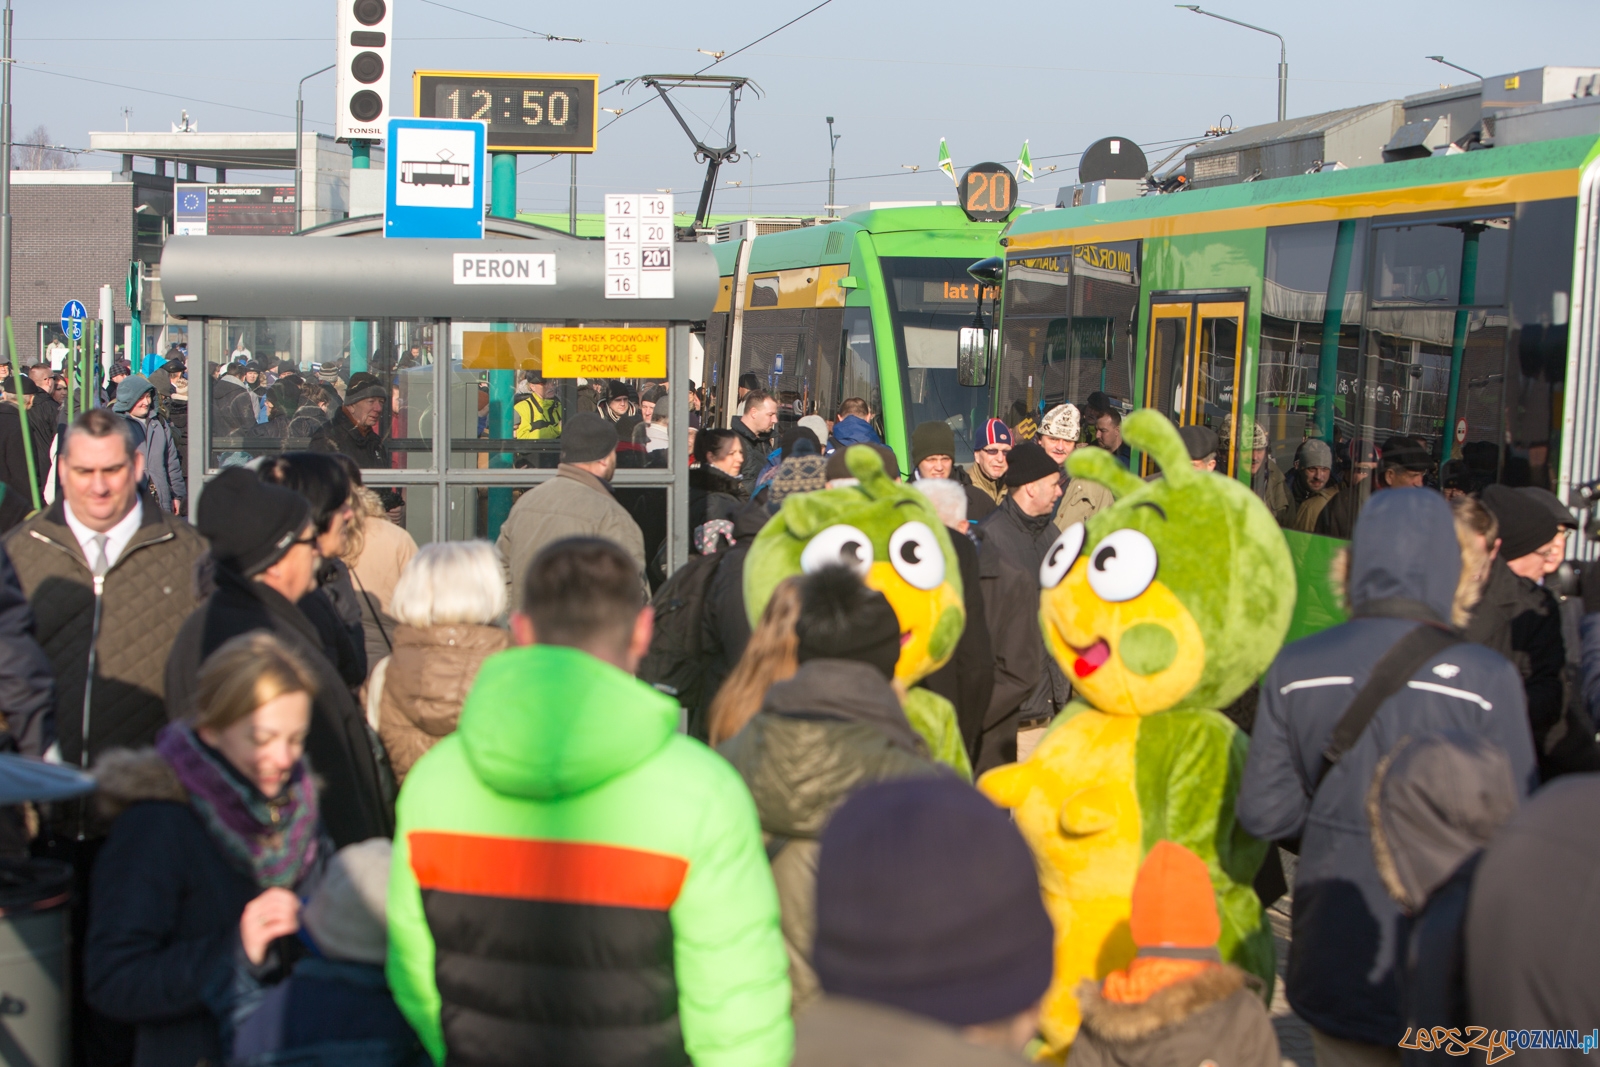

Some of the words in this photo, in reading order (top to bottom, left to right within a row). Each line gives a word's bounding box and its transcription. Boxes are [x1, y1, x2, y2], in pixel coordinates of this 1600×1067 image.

[448, 89, 569, 125] 12:50
[968, 172, 1010, 211] 20
[615, 201, 631, 214] 12
[649, 201, 665, 214] 19
[615, 227, 631, 240] 14
[648, 227, 664, 240] 20
[615, 252, 631, 265] 15
[643, 250, 669, 266] 201
[462, 260, 529, 278] PERON
[537, 260, 546, 277] 1
[615, 278, 631, 291] 16
[943, 281, 969, 299] lat
[549, 334, 607, 343] PRZYSTANEK
[610, 333, 660, 343] PODWÓJNY
[572, 344, 600, 353] DRUGI
[603, 344, 637, 354] POCIĄG
[558, 354, 573, 362] NIE
[576, 354, 633, 363] ZATRZYMUJE
[637, 354, 650, 365] SIĘ
[580, 364, 628, 372] PONOWNIE
